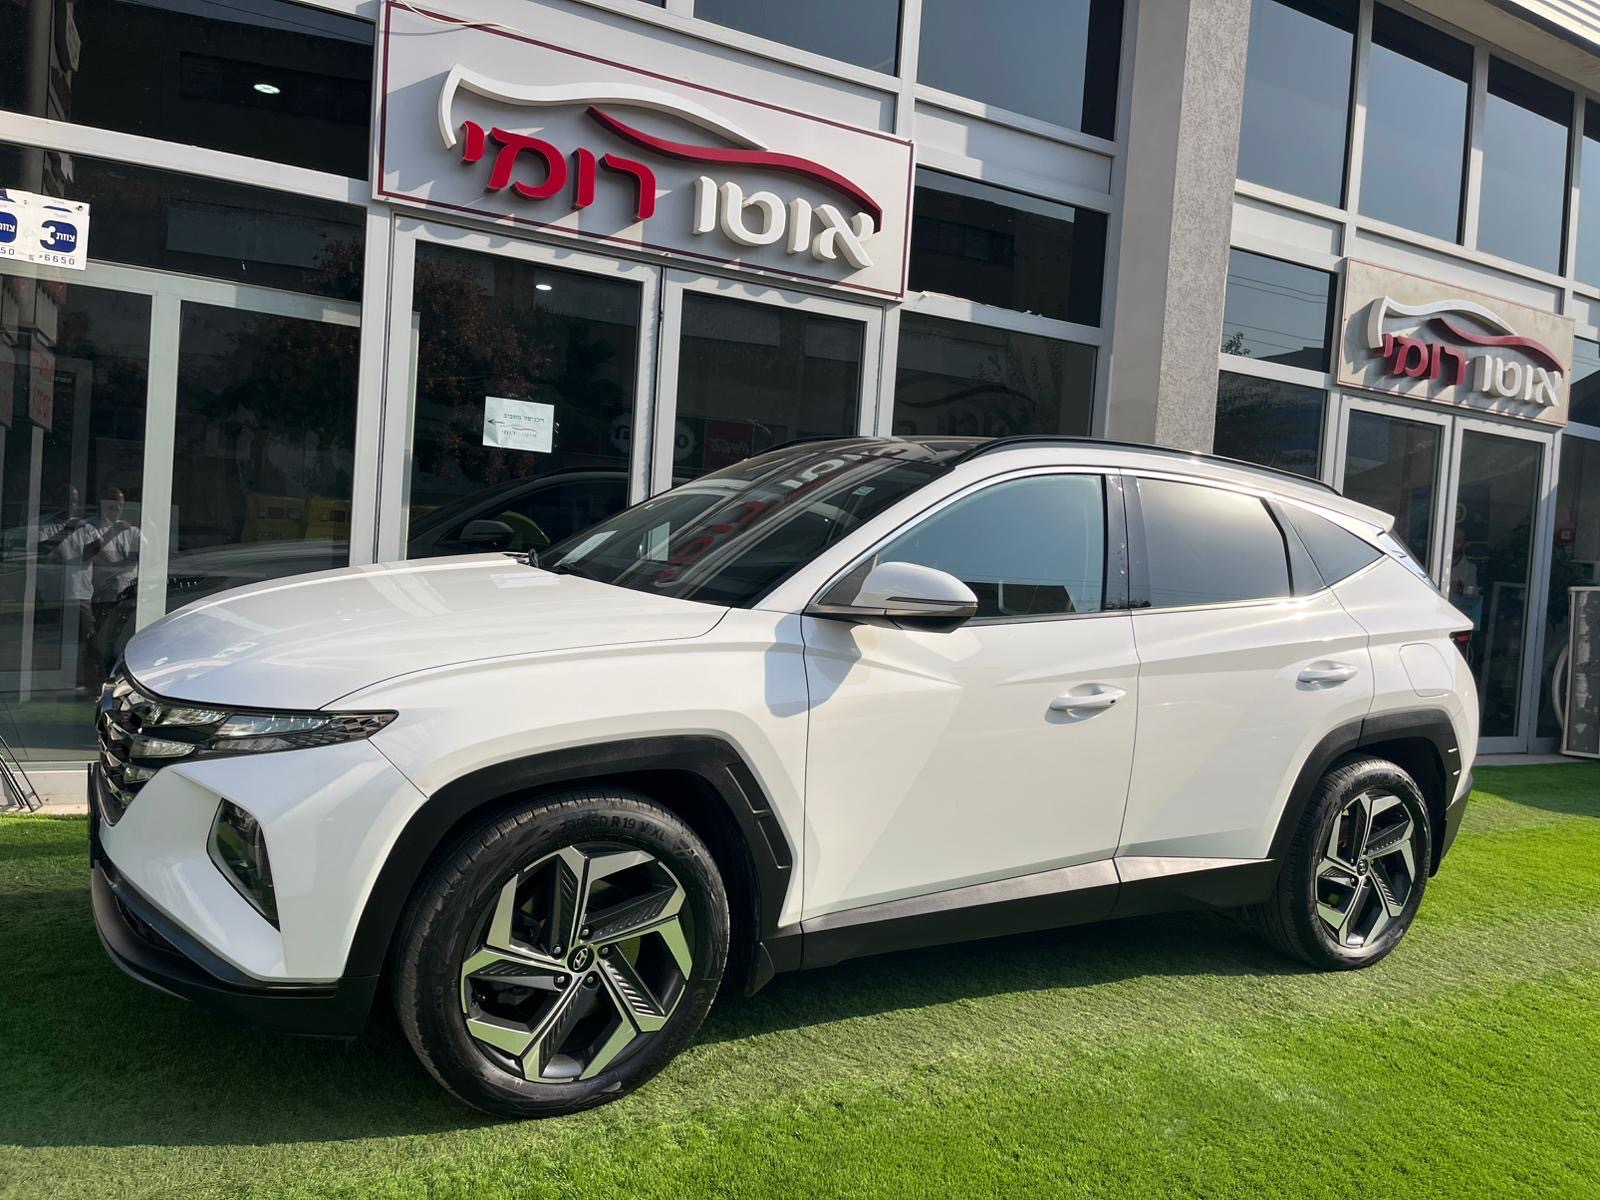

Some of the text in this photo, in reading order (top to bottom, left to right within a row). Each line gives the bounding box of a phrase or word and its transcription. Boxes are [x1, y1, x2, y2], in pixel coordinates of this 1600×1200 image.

[459, 119, 876, 269] אוטו רומי
[56, 232, 75, 242] צוות
[1379, 333, 1564, 407] אוטו רומי
